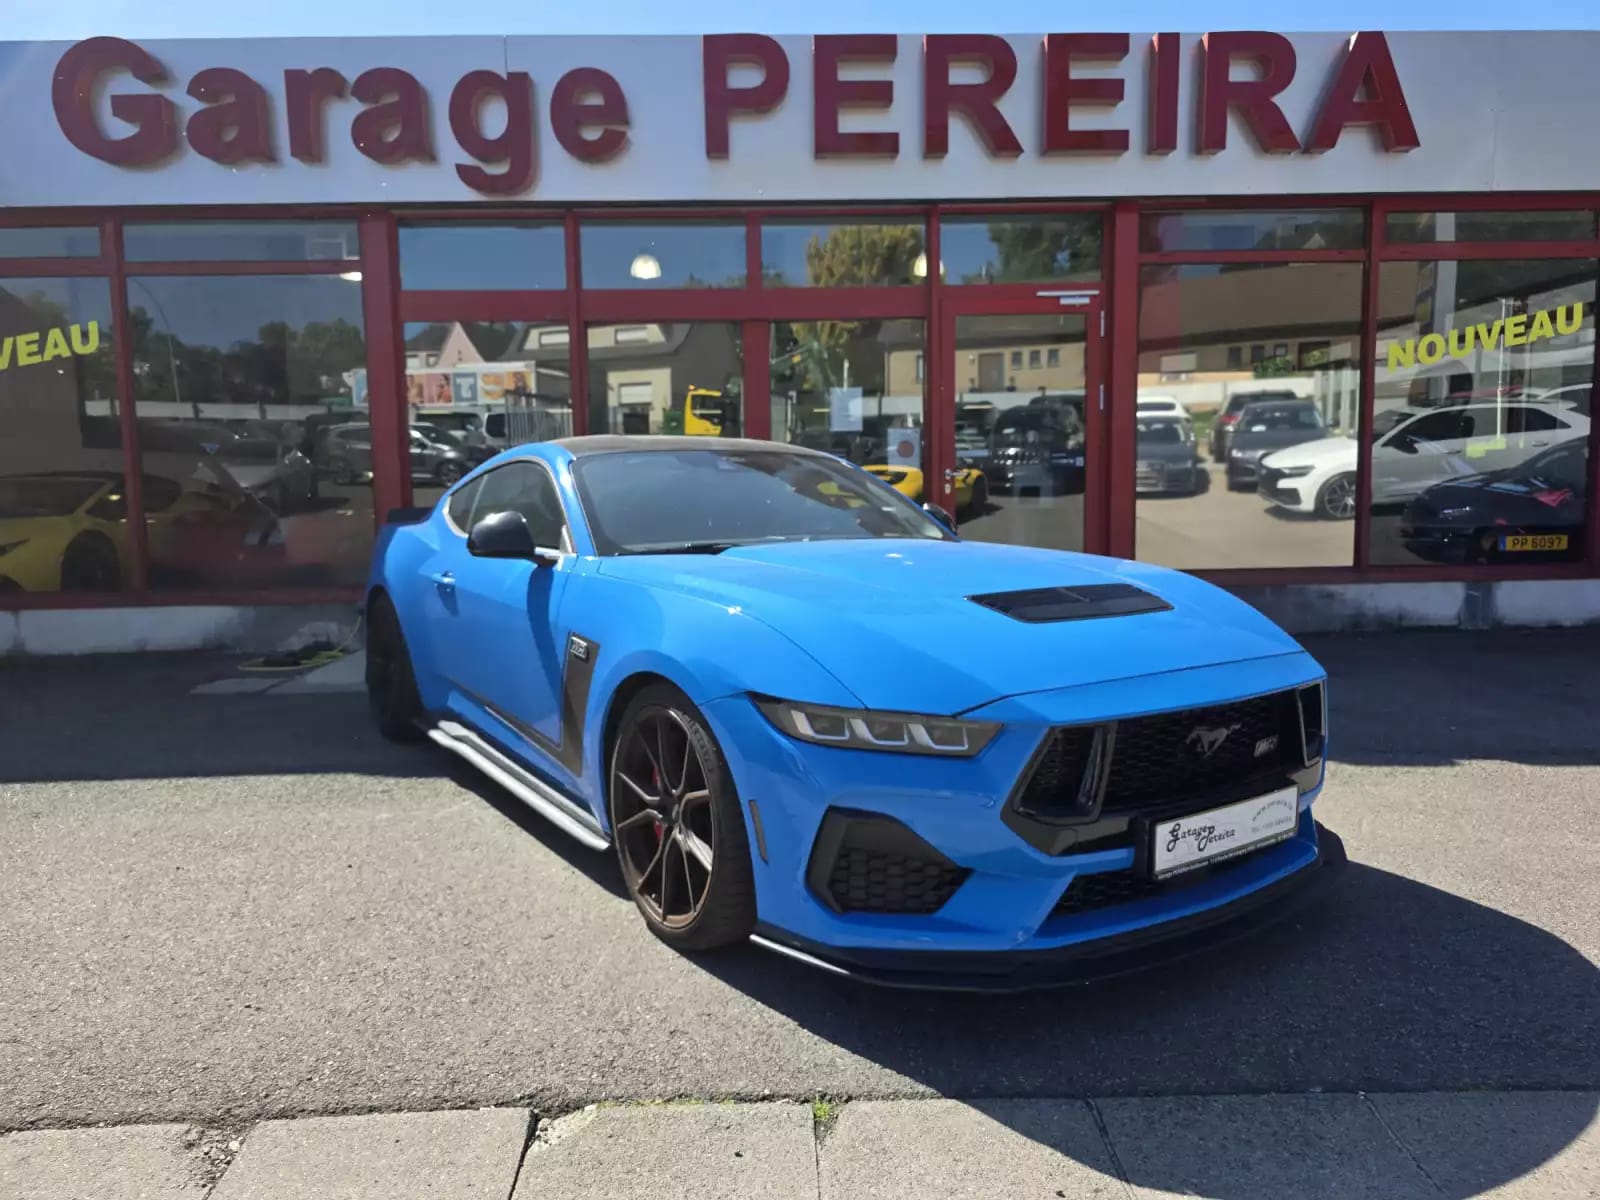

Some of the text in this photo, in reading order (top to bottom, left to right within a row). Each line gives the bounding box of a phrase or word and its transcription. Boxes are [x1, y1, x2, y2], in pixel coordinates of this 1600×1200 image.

[51, 31, 1420, 196] Garage PEREIRA
[1387, 302, 1584, 371] NOUVEAU
